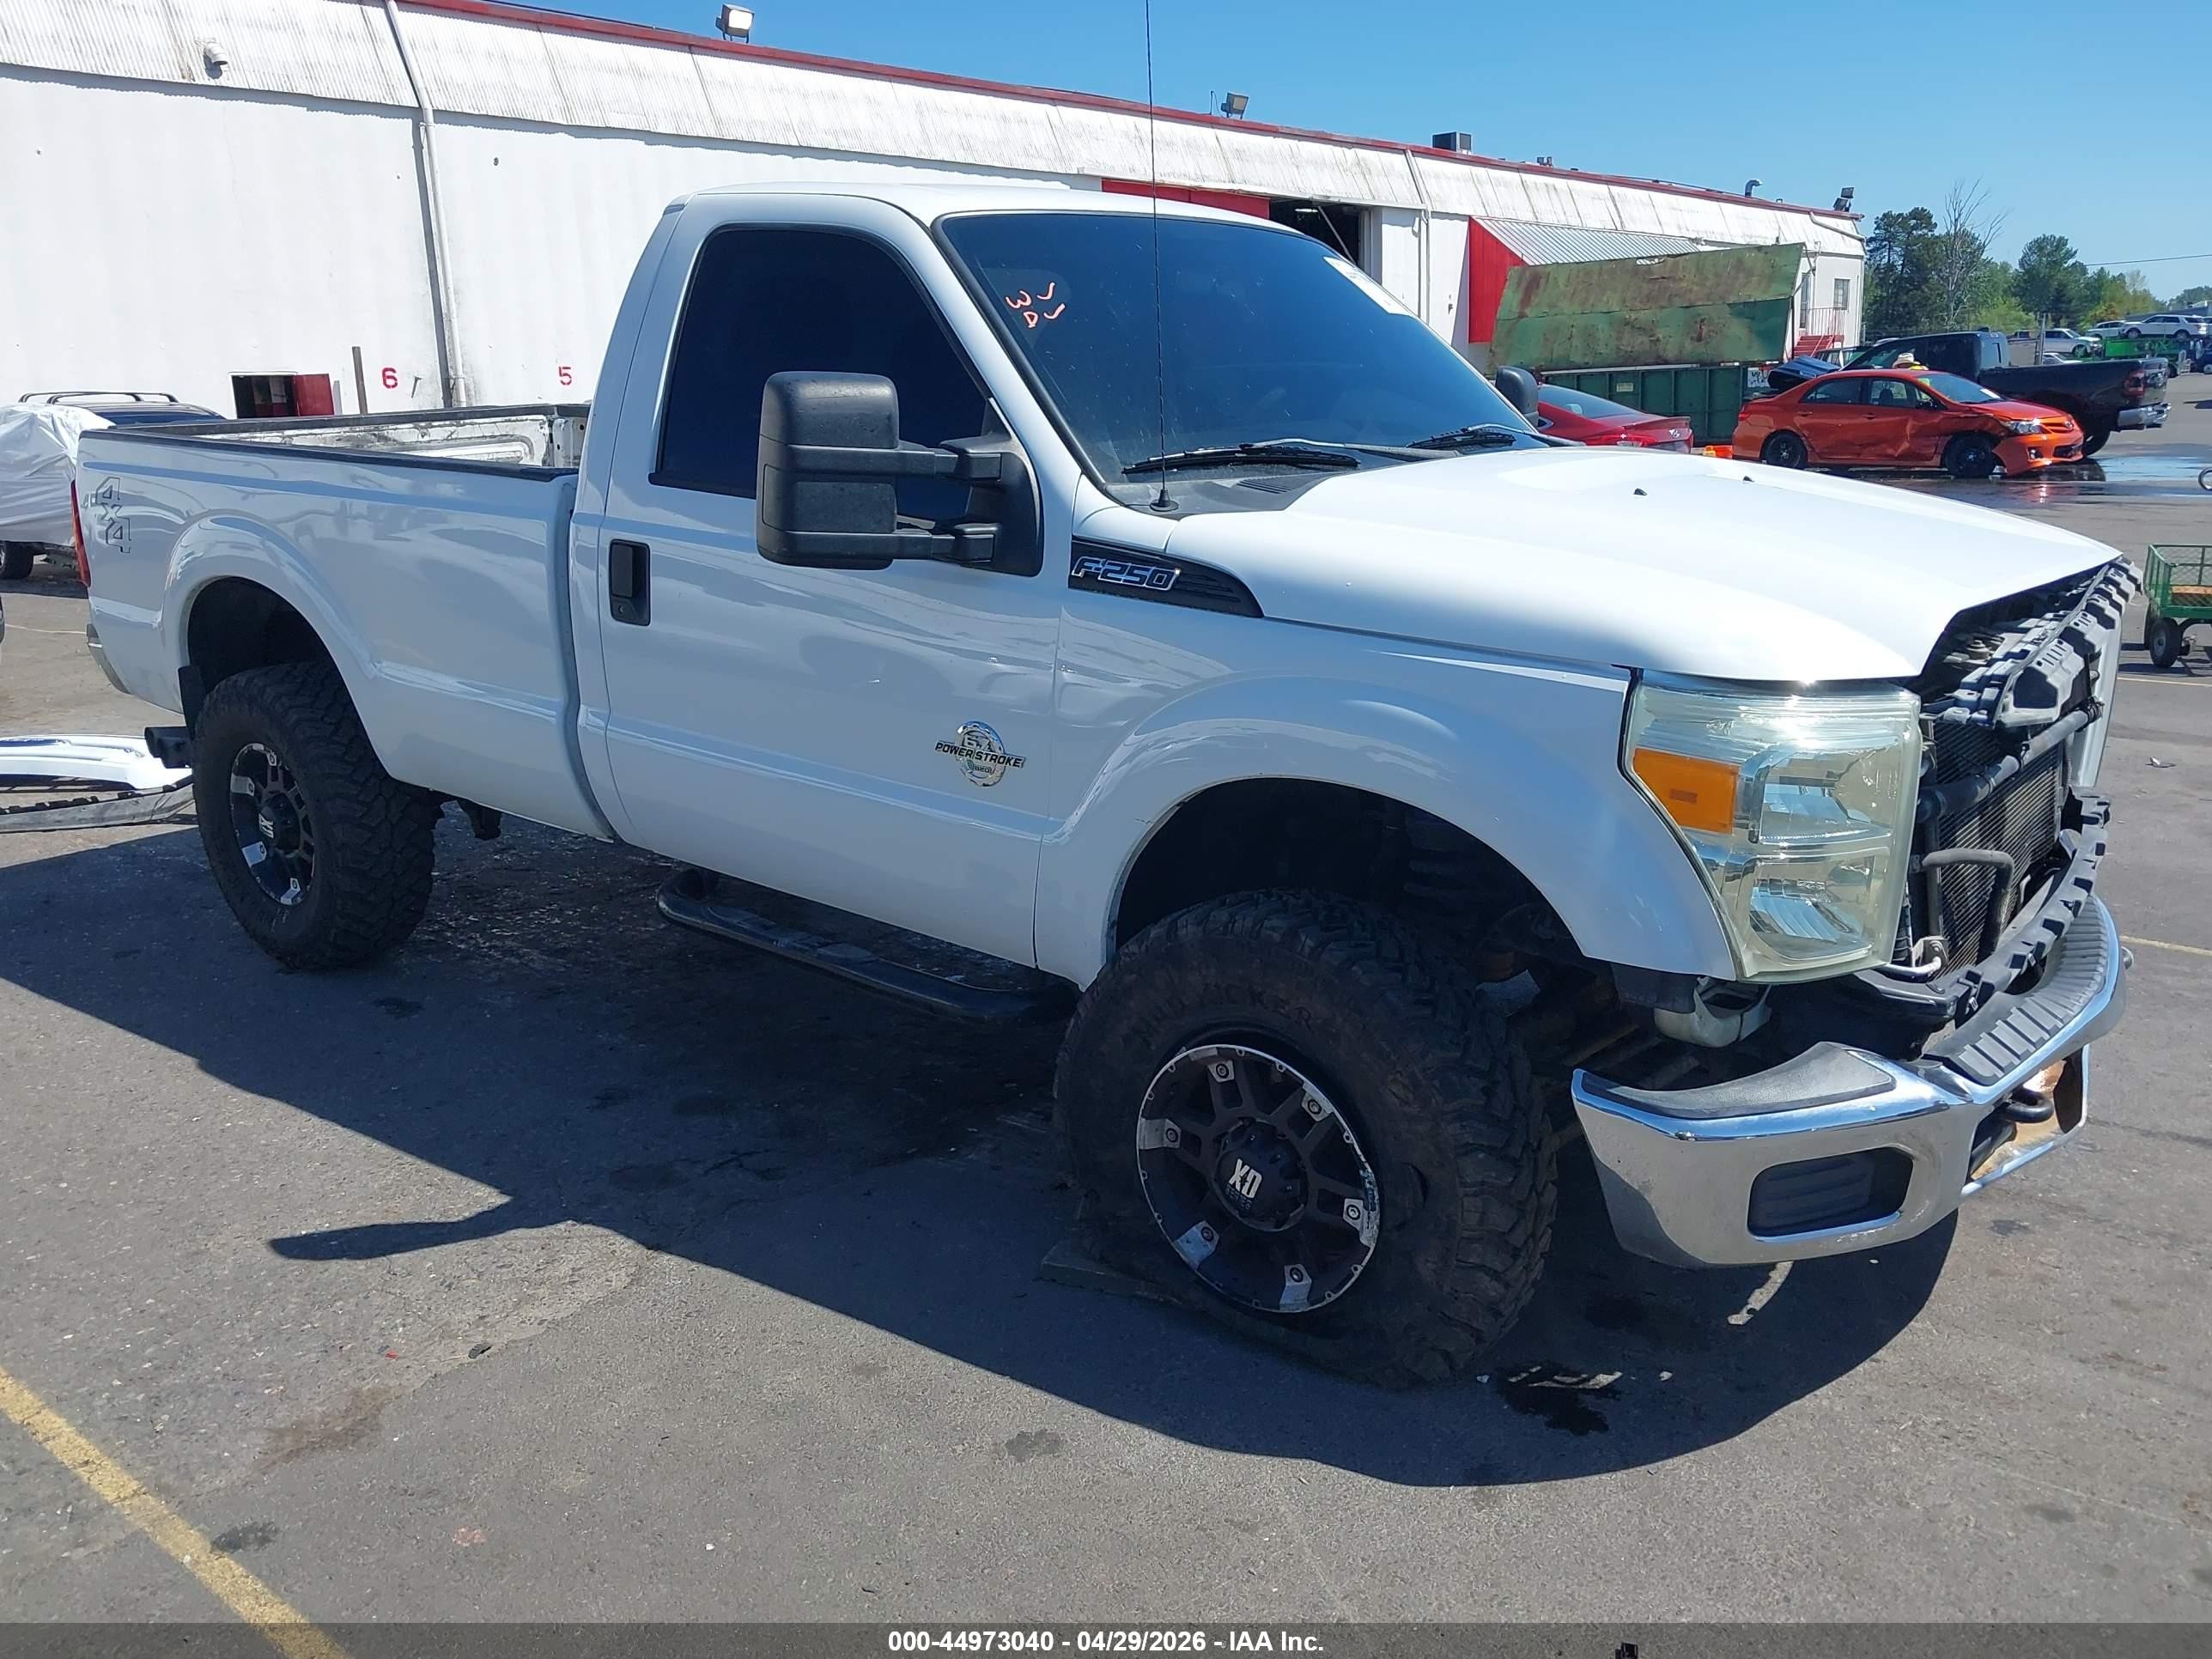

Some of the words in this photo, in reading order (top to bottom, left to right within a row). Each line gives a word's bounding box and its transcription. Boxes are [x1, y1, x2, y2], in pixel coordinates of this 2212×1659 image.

[380, 367, 399, 390] 6
[558, 365, 573, 386] 5
[934, 741, 975, 760] POWER
[975, 751, 1026, 769] STROKE
[1228, 1158, 1262, 1200] XD
